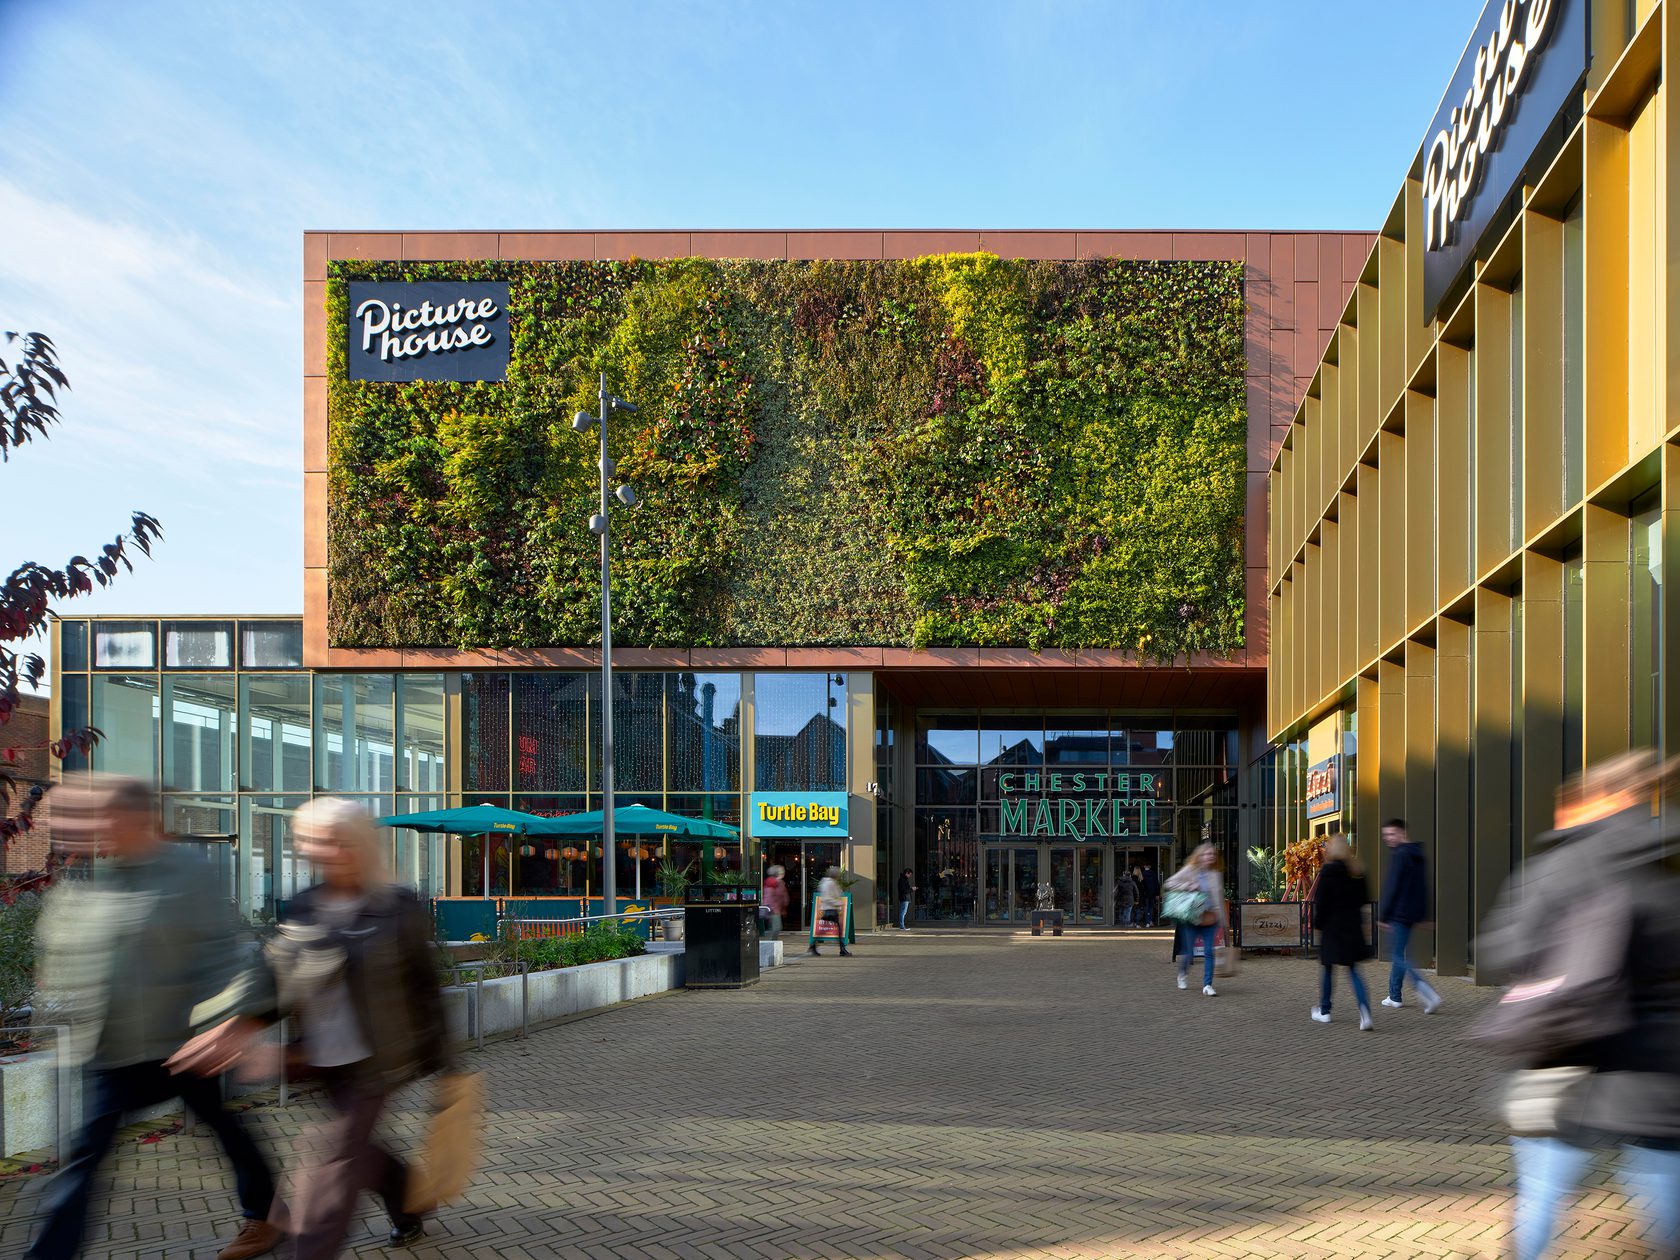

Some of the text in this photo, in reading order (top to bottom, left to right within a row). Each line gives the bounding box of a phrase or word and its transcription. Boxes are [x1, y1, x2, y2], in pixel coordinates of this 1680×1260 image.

[1422, 0, 1525, 252] Pictu
[356, 298, 498, 351] Picture
[381, 324, 492, 360] house
[999, 773, 1155, 792] CHESTER
[757, 802, 839, 826] Turtle Bay
[999, 798, 1156, 842] MARKET
